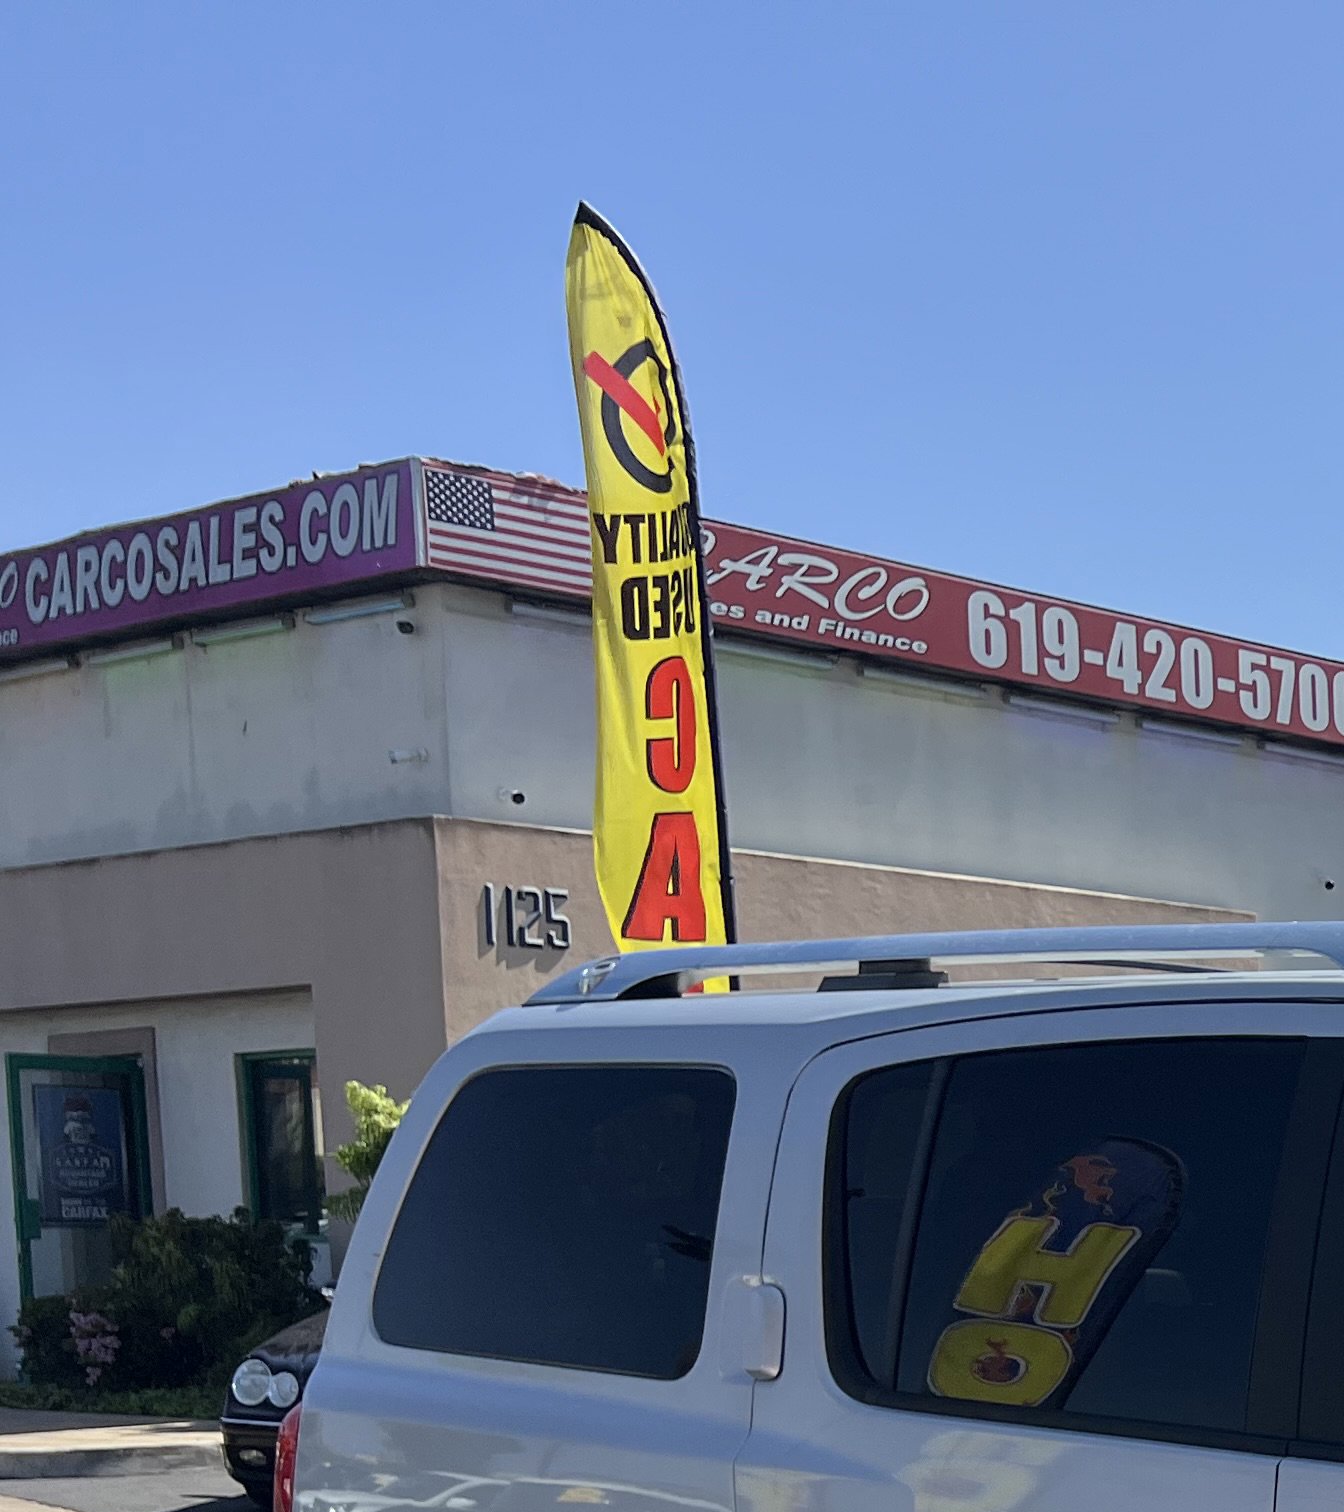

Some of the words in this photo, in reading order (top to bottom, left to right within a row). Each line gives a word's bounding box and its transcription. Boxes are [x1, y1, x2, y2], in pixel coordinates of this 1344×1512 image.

[25, 471, 399, 624] CARCOSALES.COM
[755, 608, 809, 631] and
[817, 618, 929, 655] Finance
[483, 882, 571, 949] 1125
